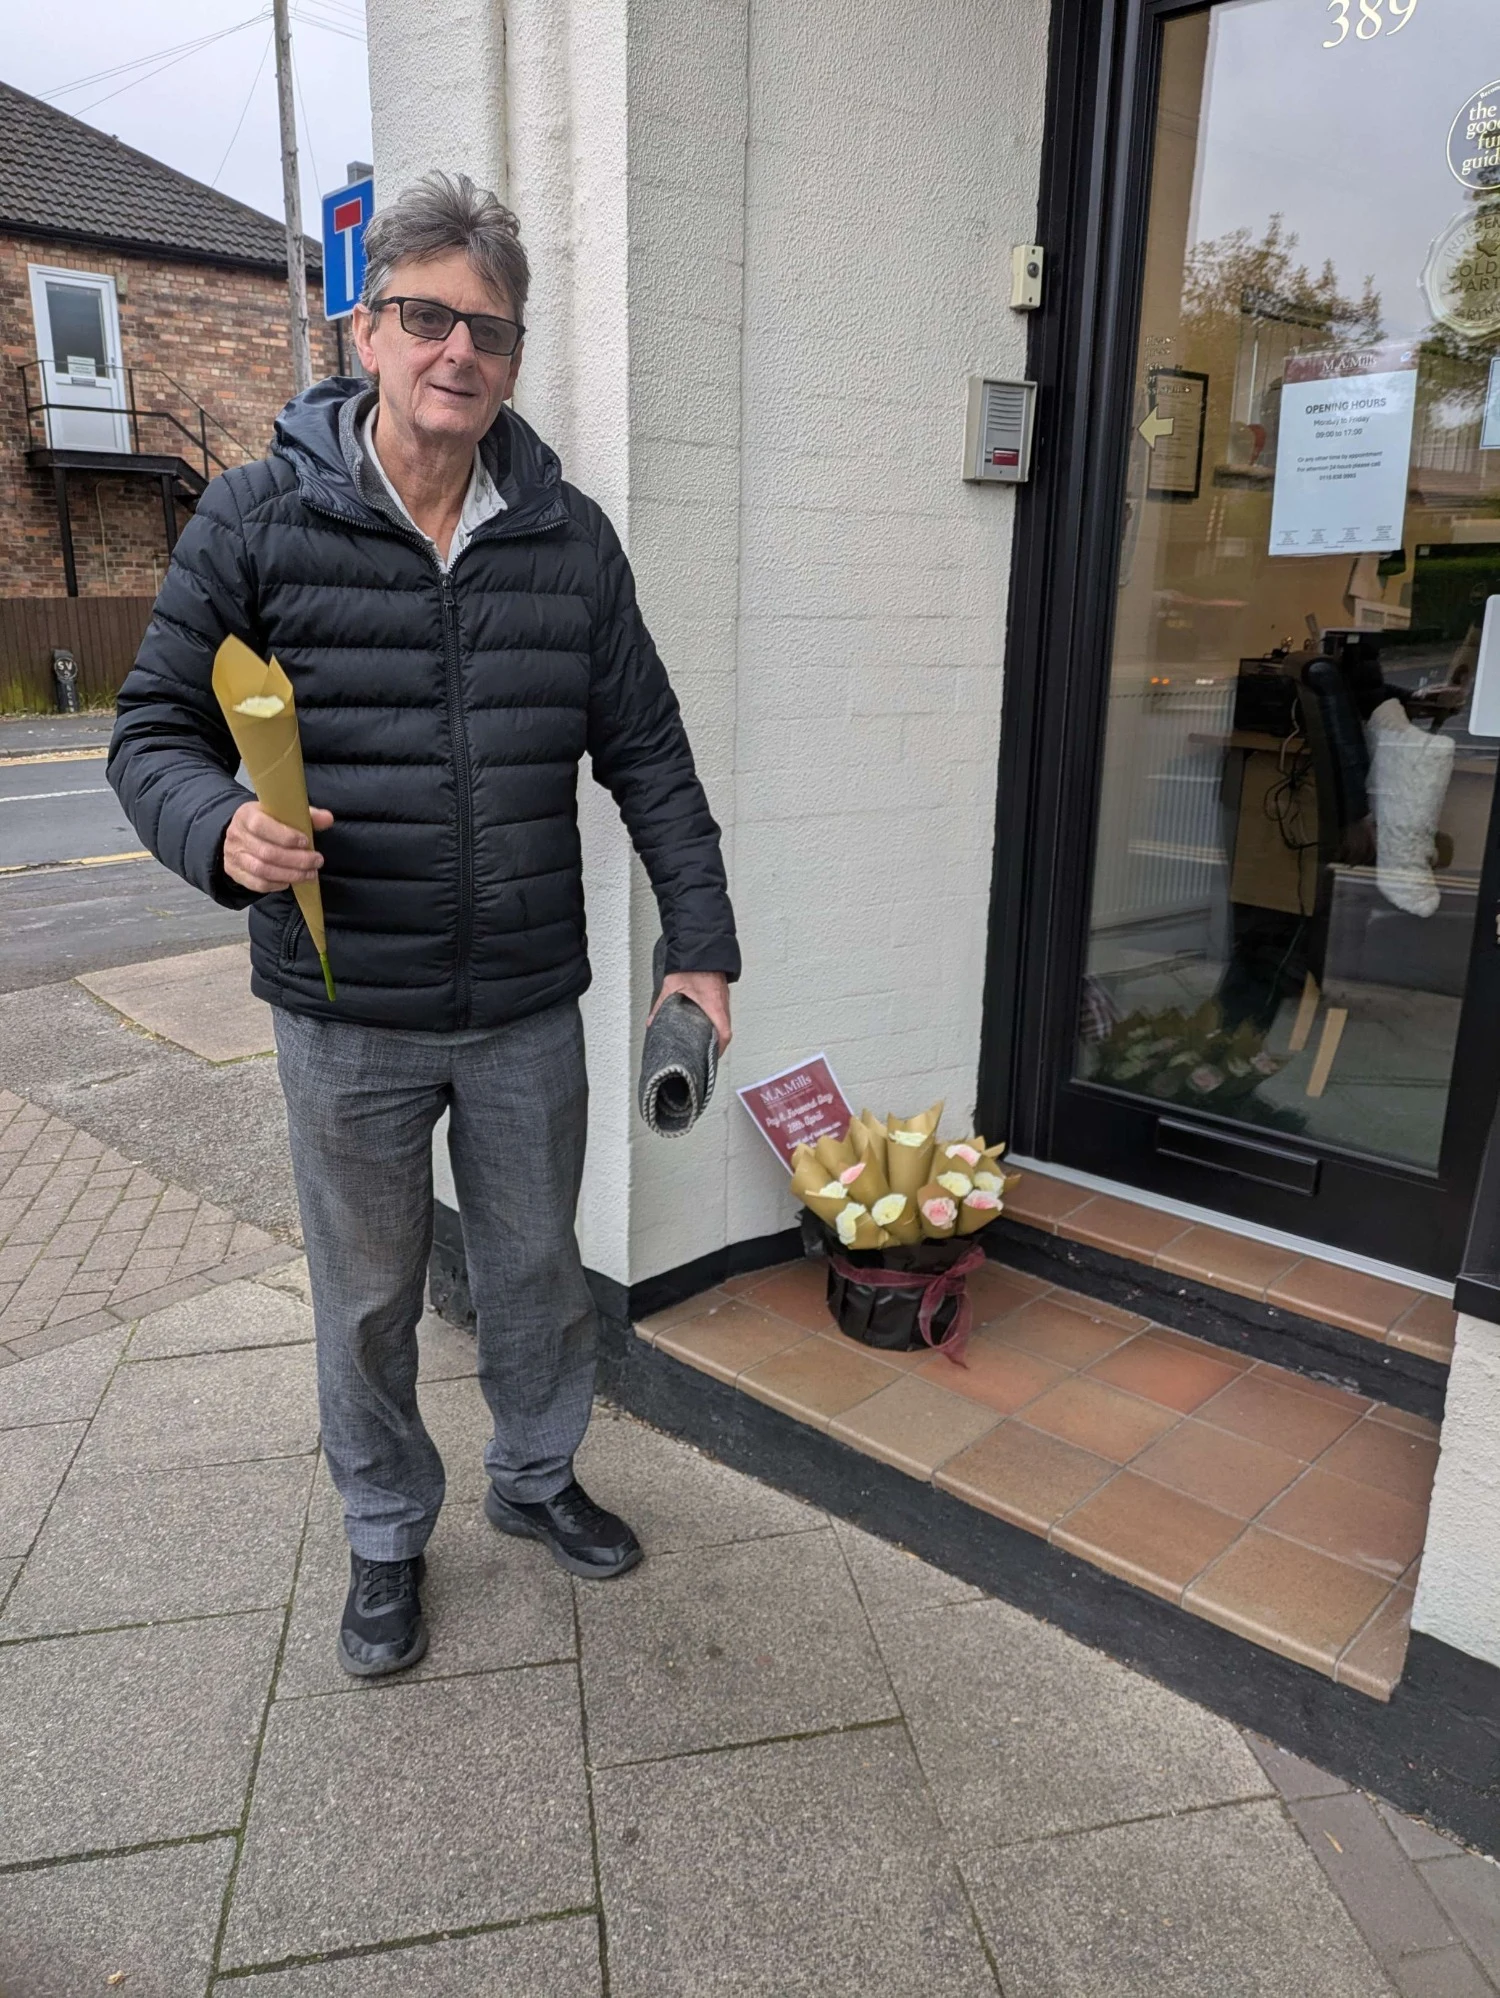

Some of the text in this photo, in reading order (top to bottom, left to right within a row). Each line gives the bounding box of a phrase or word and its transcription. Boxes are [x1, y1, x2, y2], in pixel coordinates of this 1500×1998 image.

[1322, 0, 1417, 48] 389
[1469, 101, 1497, 121] the
[1305, 398, 1387, 414] OPENING HOURS
[1313, 418, 1339, 427] Monday
[1348, 415, 1371, 424] Friday
[1344, 428, 1363, 436] 17:00
[58, 661, 73, 670] SV
